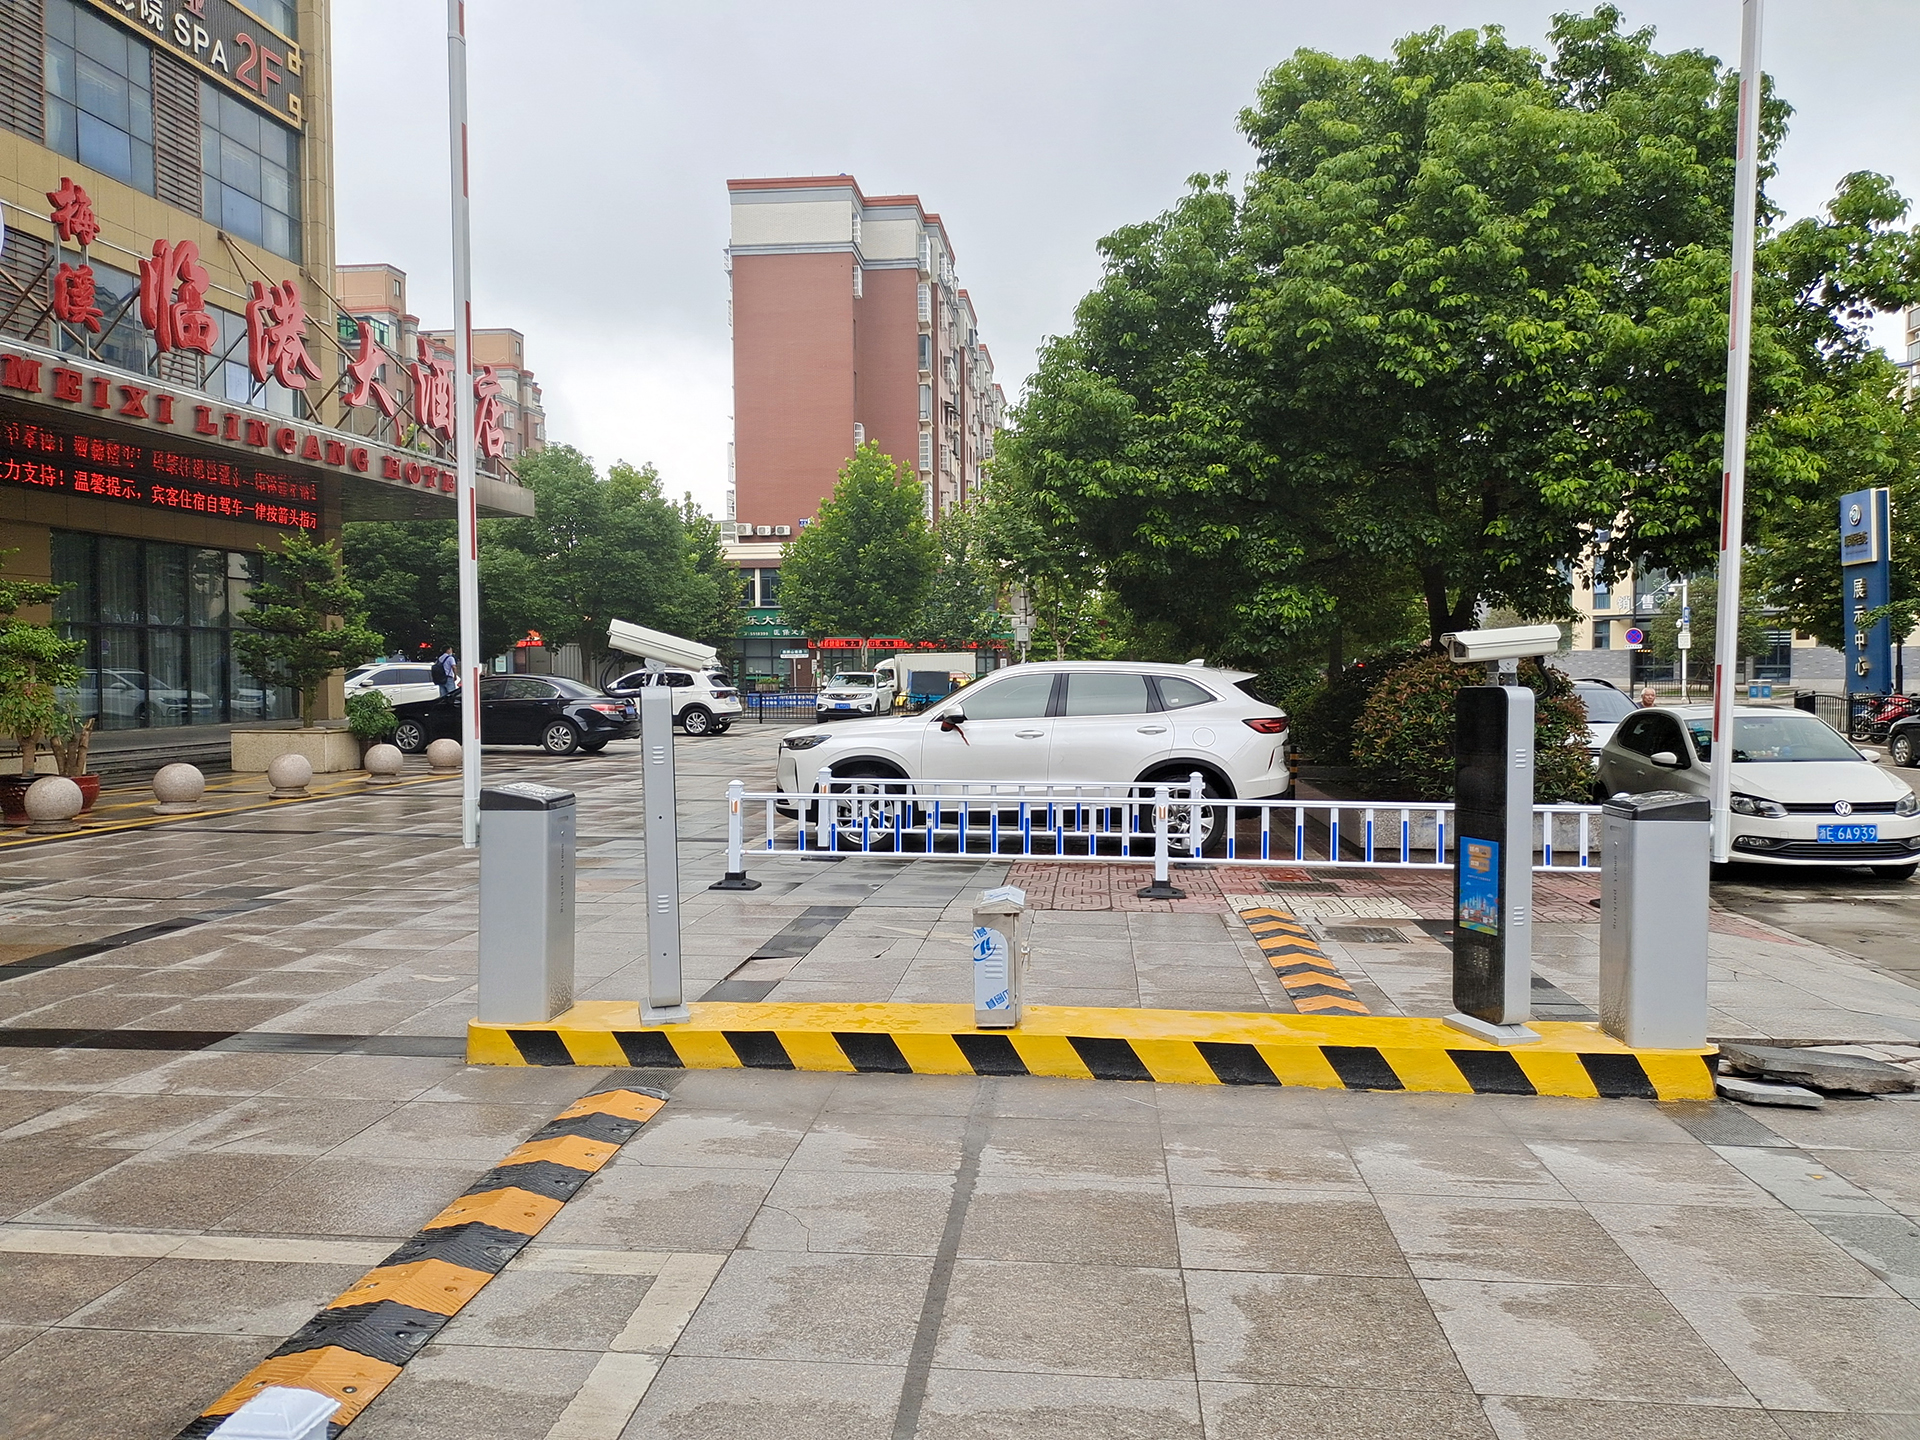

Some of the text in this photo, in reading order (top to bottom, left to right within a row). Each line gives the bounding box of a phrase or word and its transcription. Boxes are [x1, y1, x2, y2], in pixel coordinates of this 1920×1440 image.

[174, 12, 229, 73] SPA
[235, 32, 283, 97] 2F
[1, 353, 175, 425] MEIXI
[195, 404, 369, 473] LINGANG
[383, 454, 458, 493] HOTE
[1852, 577, 1870, 677] 展示中心
